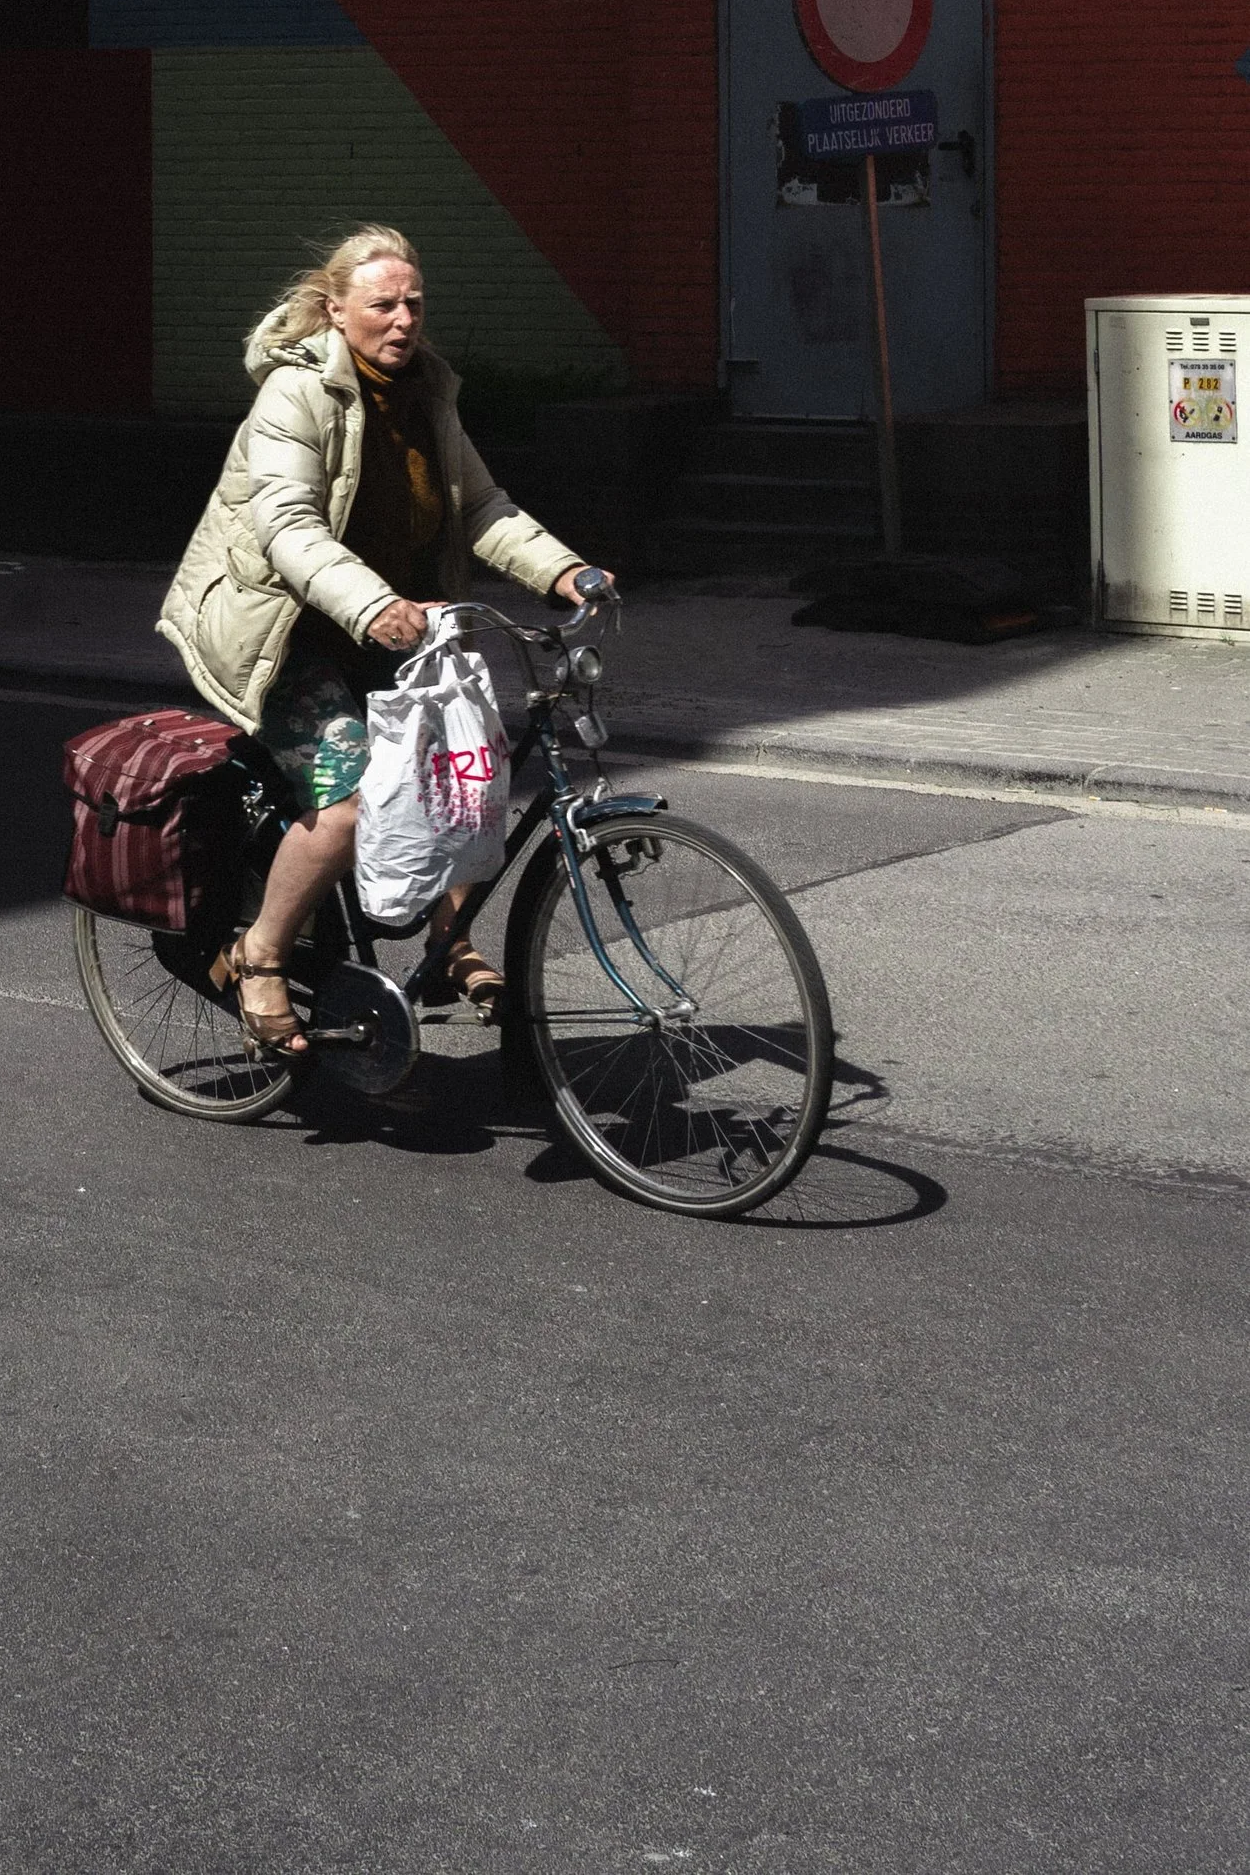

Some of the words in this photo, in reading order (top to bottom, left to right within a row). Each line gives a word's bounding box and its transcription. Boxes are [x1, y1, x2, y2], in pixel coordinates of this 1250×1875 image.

[829, 99, 911, 124] UITGEZONDERD
[808, 128, 882, 154] PLAATSELIJK
[886, 123, 935, 146] VERKEER
[1183, 377, 1190, 389] P
[1198, 377, 1219, 389] 282
[1185, 431, 1223, 439] AARDGAS
